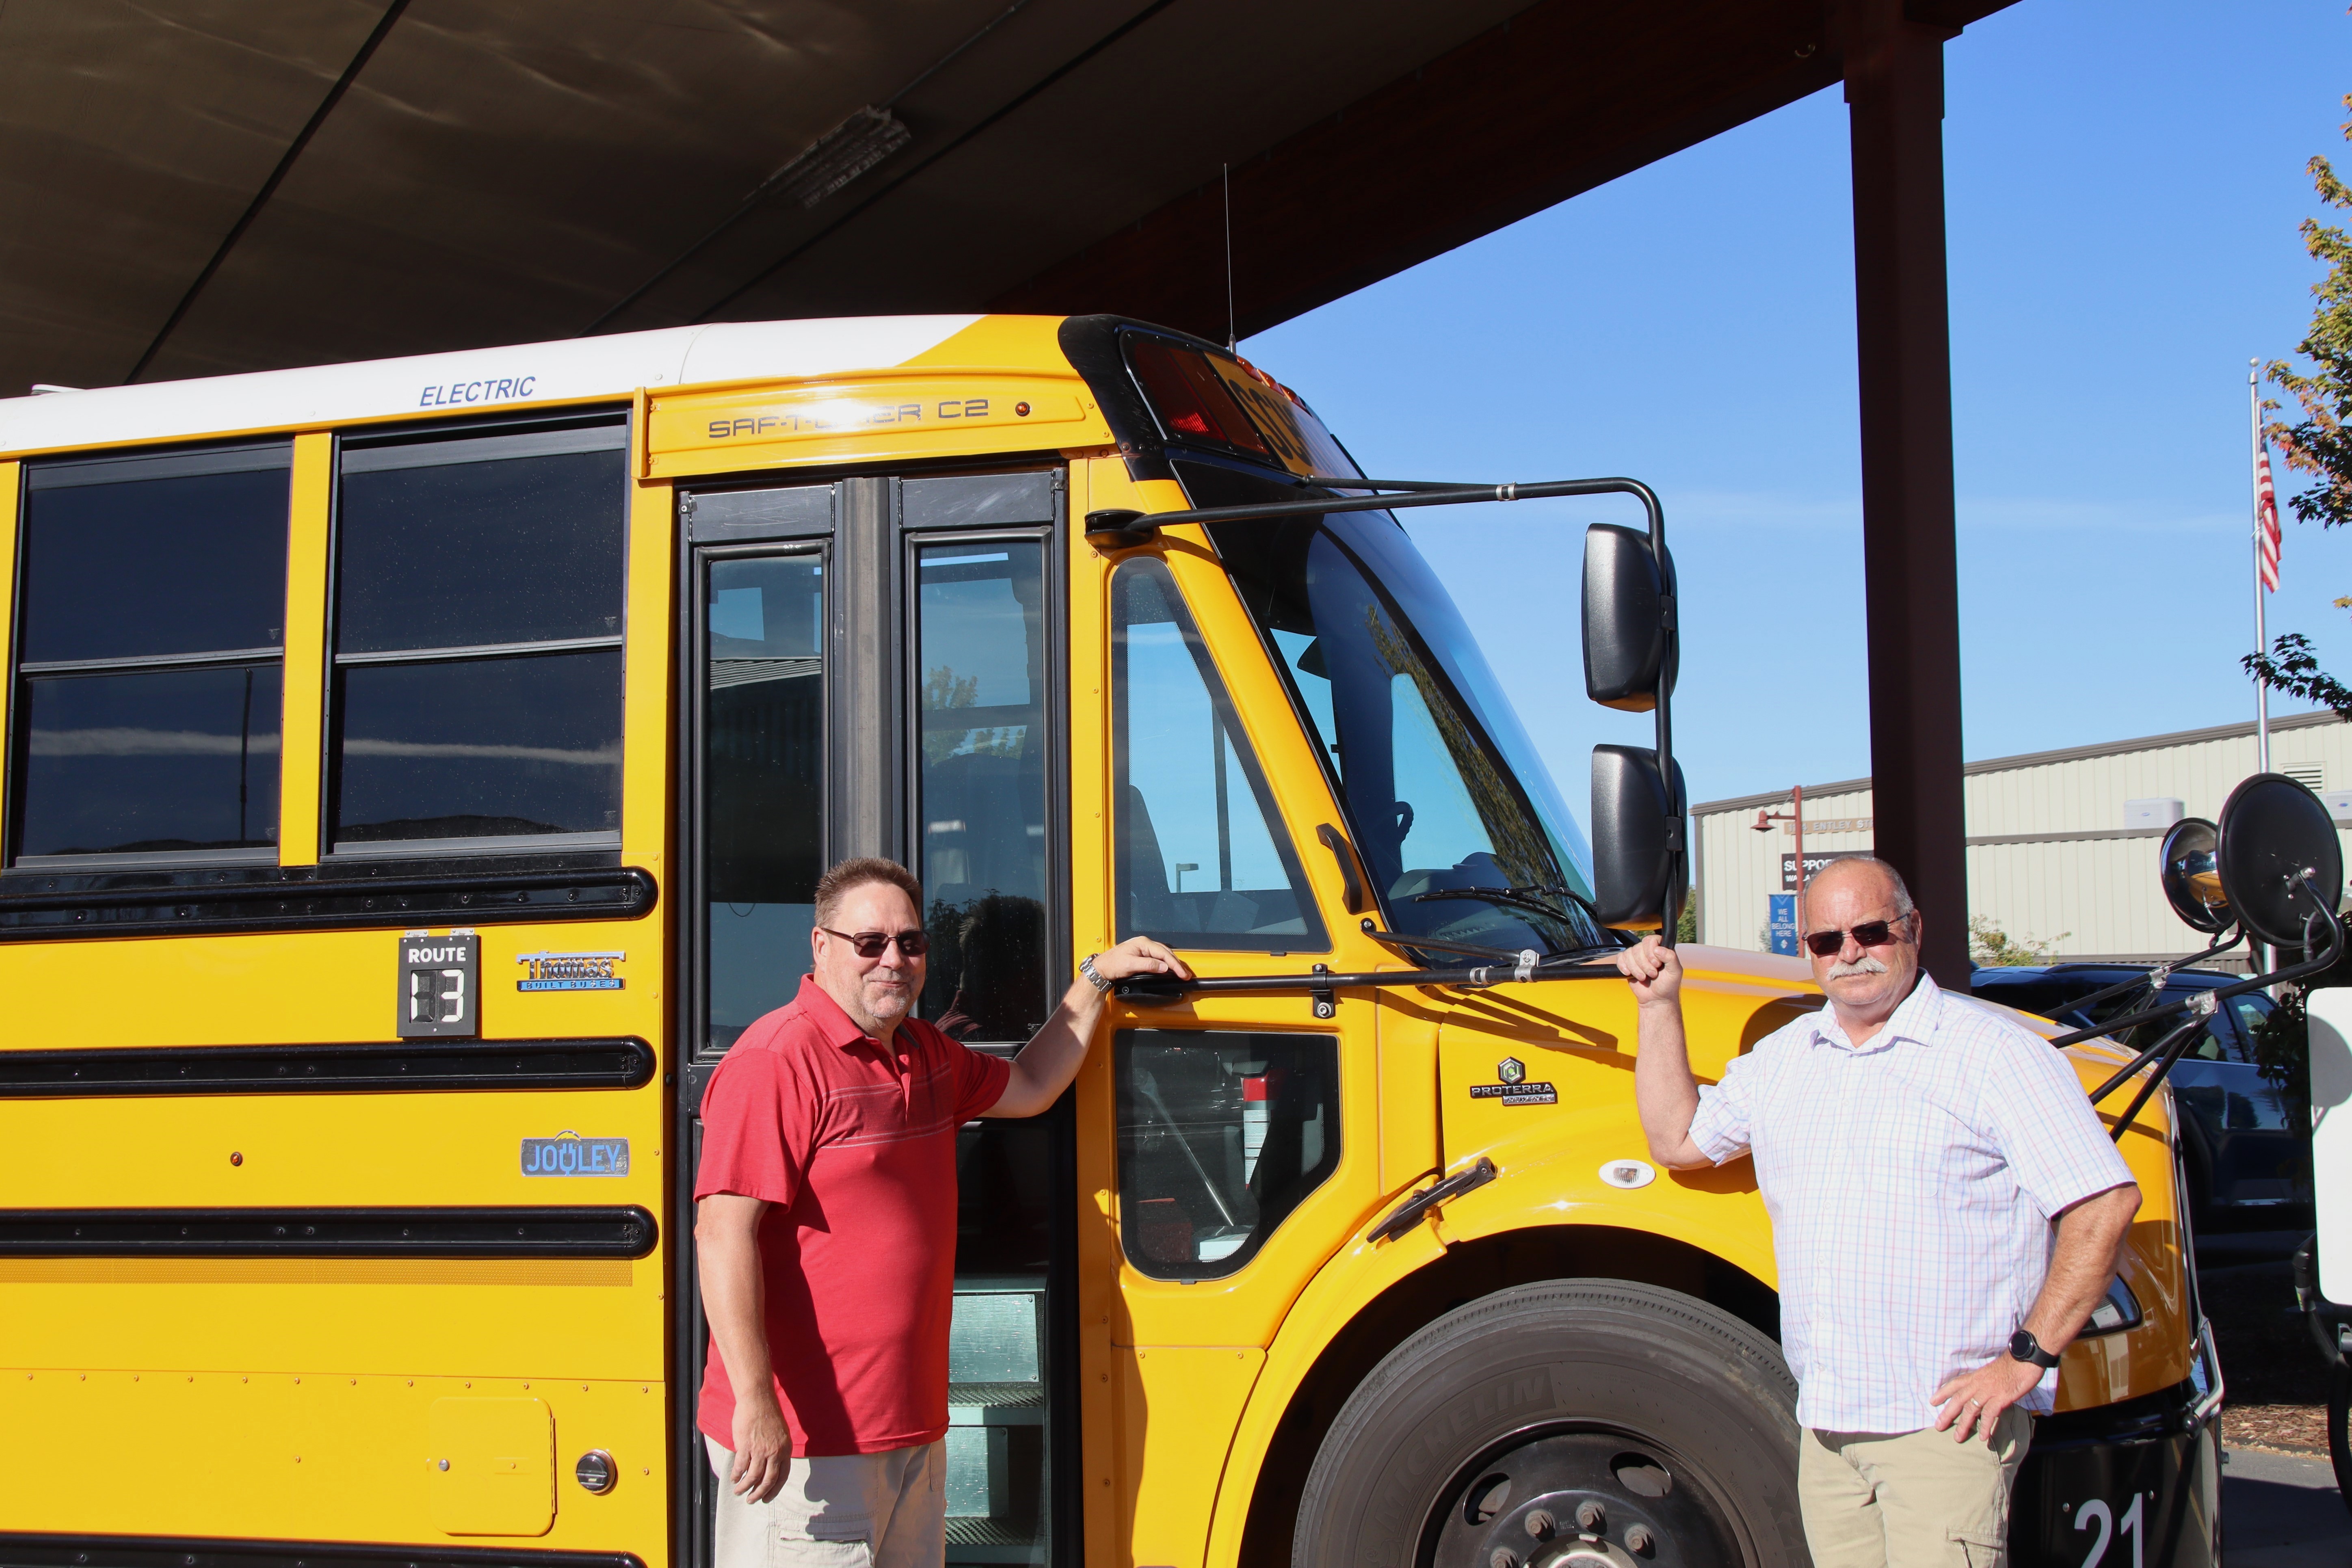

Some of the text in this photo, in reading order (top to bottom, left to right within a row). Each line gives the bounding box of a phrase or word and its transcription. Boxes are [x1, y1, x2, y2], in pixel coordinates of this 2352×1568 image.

[420, 376, 536, 407] ELECTRIC
[709, 399, 989, 438] SAF-T-LER C2
[1813, 820, 1852, 831] ENTLEY
[1783, 859, 1832, 872] SUPPO
[408, 947, 467, 963] ROUTE
[517, 951, 626, 980] Thomas
[411, 969, 464, 1023] 13
[526, 979, 615, 989] BUILT BUSES
[1471, 1084, 1554, 1096] PROTERRA
[526, 1143, 621, 1176] JOULEY
[1374, 1375, 1546, 1533] MICHELIN
[2074, 1492, 2143, 1568] 21
